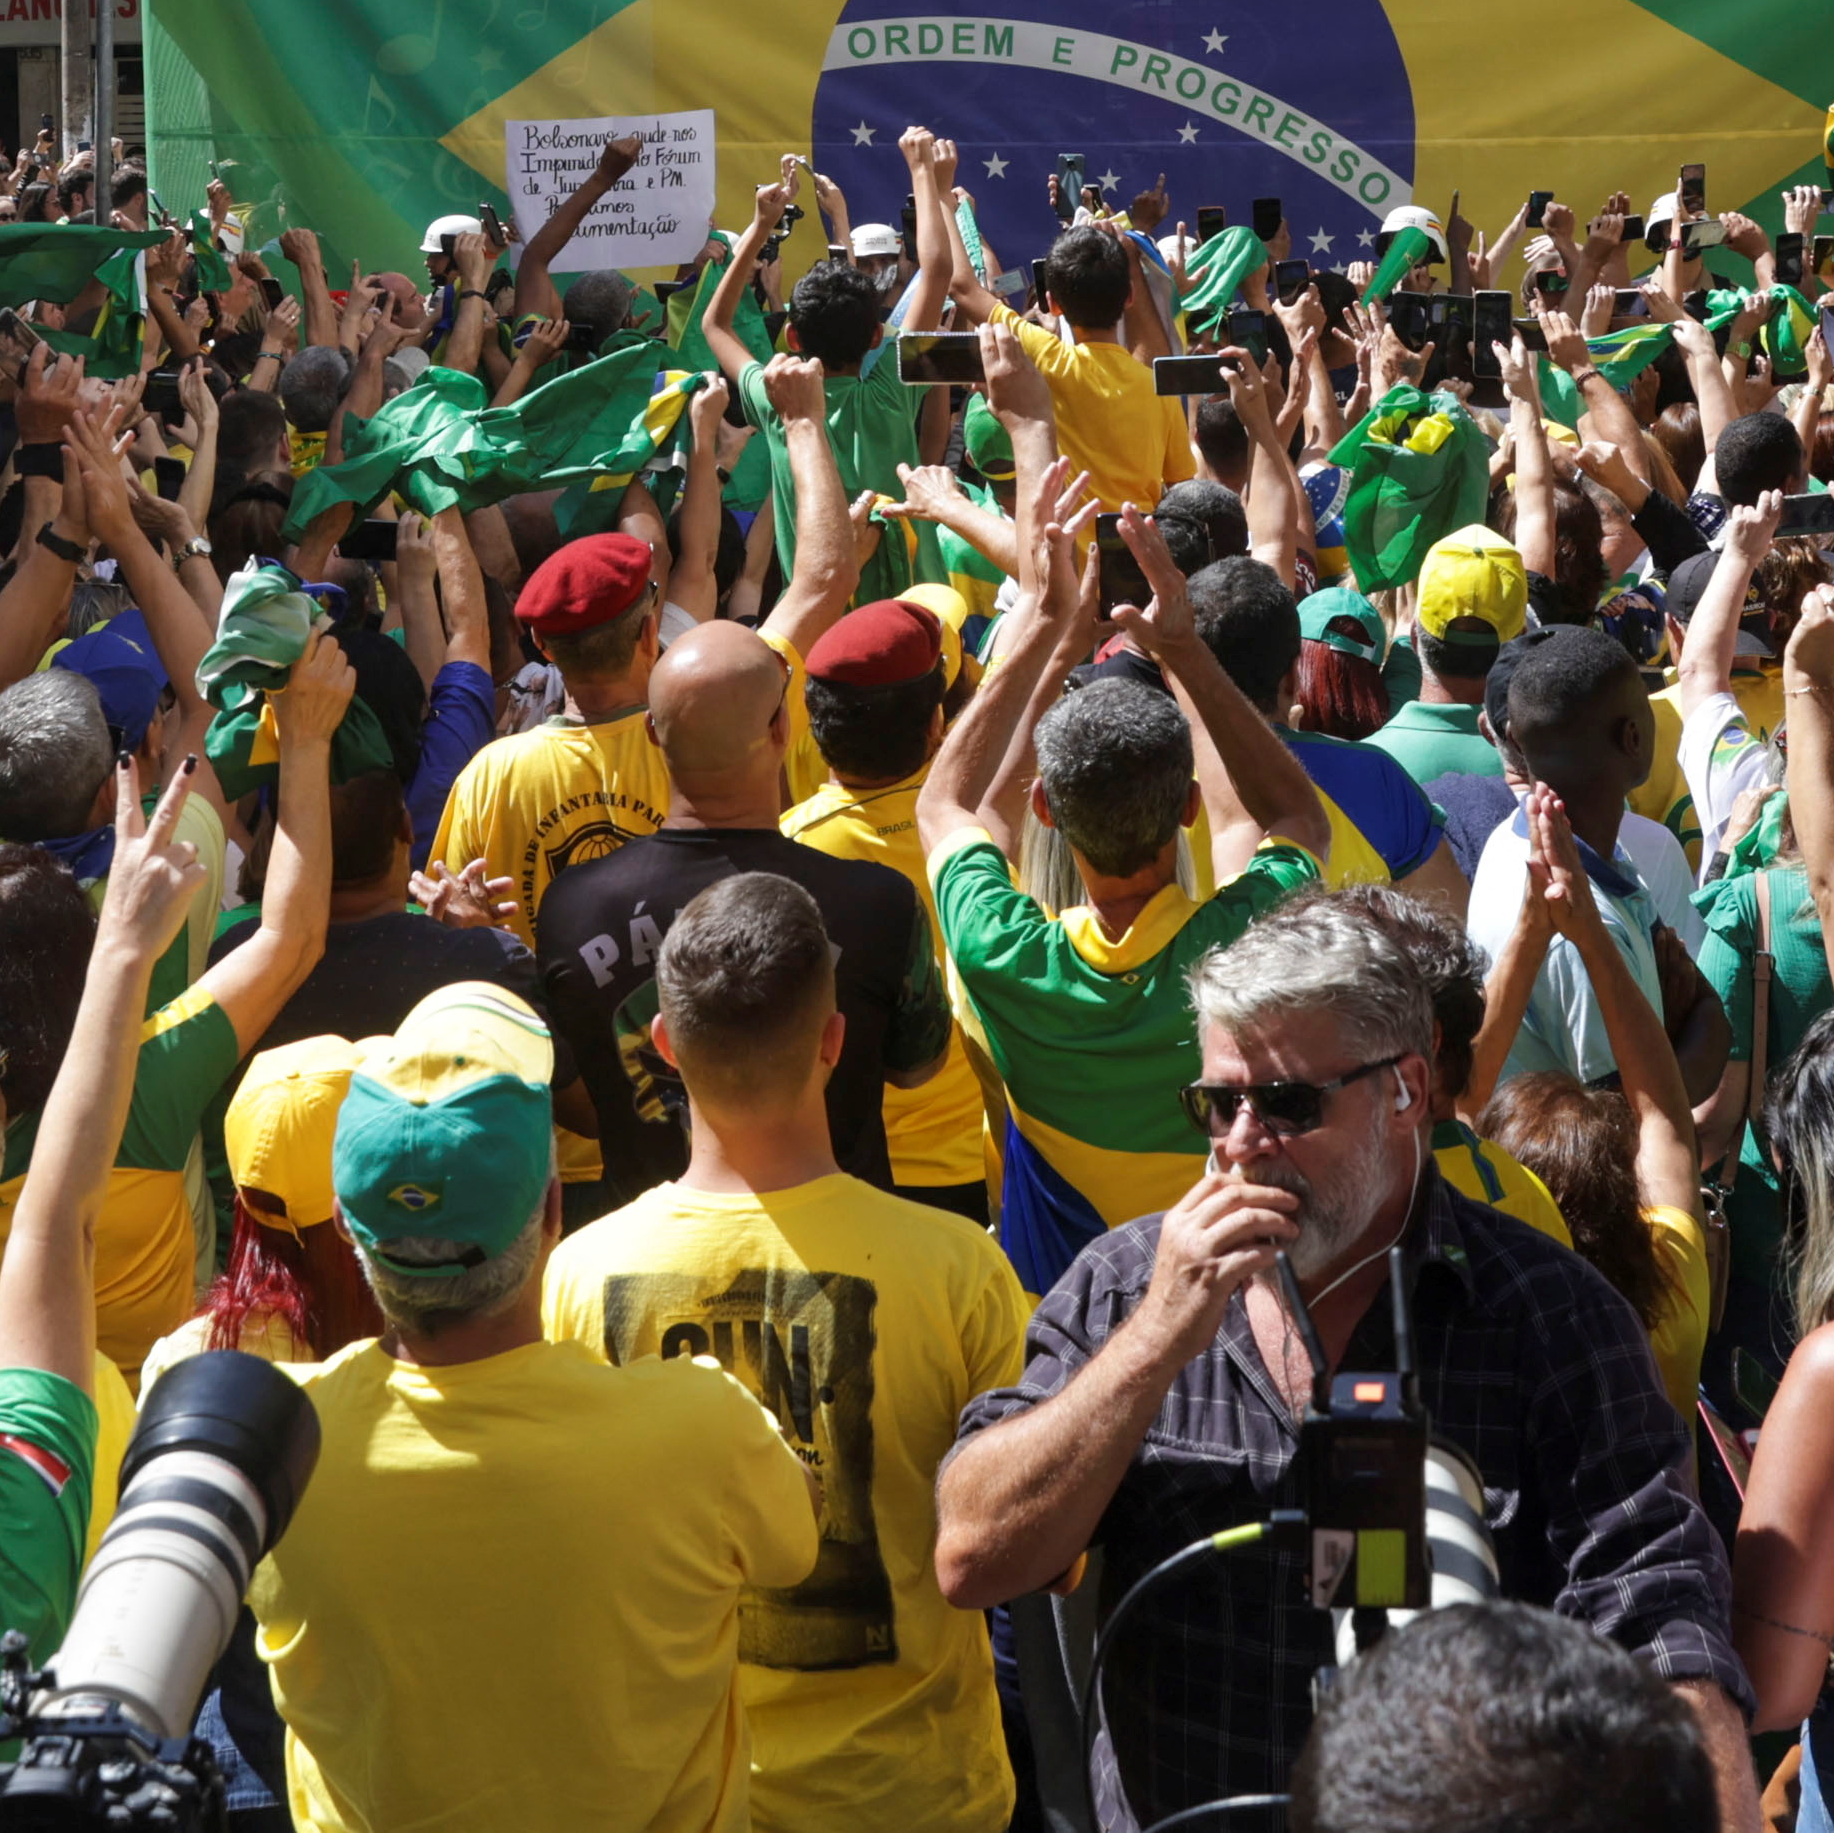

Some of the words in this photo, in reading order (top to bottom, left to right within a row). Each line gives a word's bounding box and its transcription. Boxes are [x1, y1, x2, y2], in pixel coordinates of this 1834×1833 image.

[847, 23, 1015, 59] ORDEM
[1052, 36, 1075, 65] E
[1110, 44, 1392, 207] PROGRESSO
[523, 177, 542, 196] de
[647, 179, 655, 189] e
